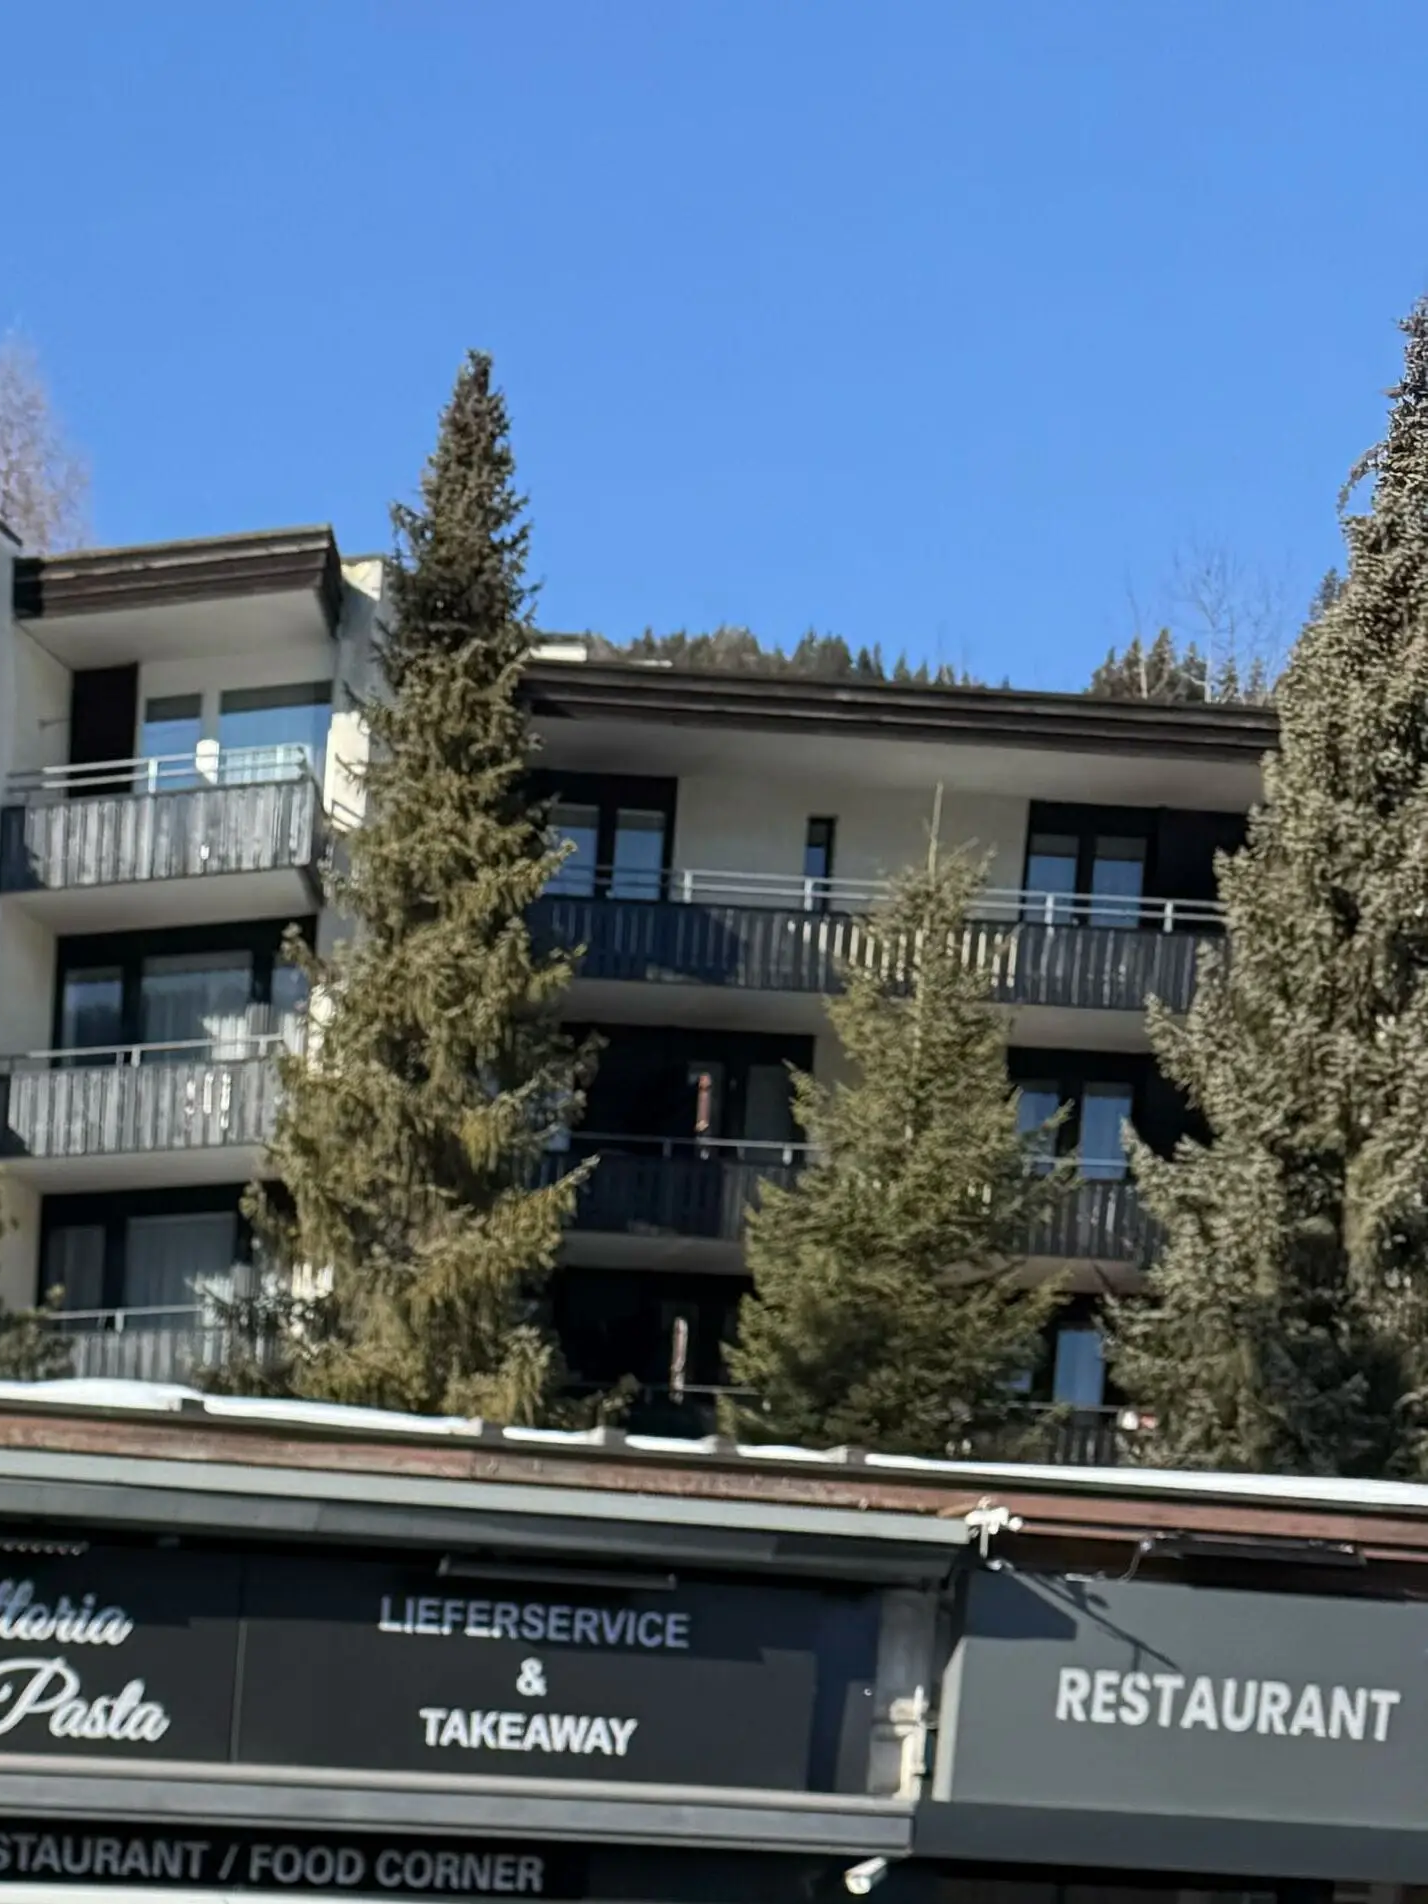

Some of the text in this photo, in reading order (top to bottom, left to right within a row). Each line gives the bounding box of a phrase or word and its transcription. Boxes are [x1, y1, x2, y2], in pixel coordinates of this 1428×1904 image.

[377, 1594, 691, 1649] LIEFERSERVICE
[515, 1656, 548, 1697] &
[1055, 1665, 1402, 1742] RESTAURANT
[418, 1706, 639, 1757] TAKEAWAY
[217, 1843, 240, 1881] /
[248, 1844, 367, 1886] FOOD
[375, 1849, 544, 1893] CORNER
